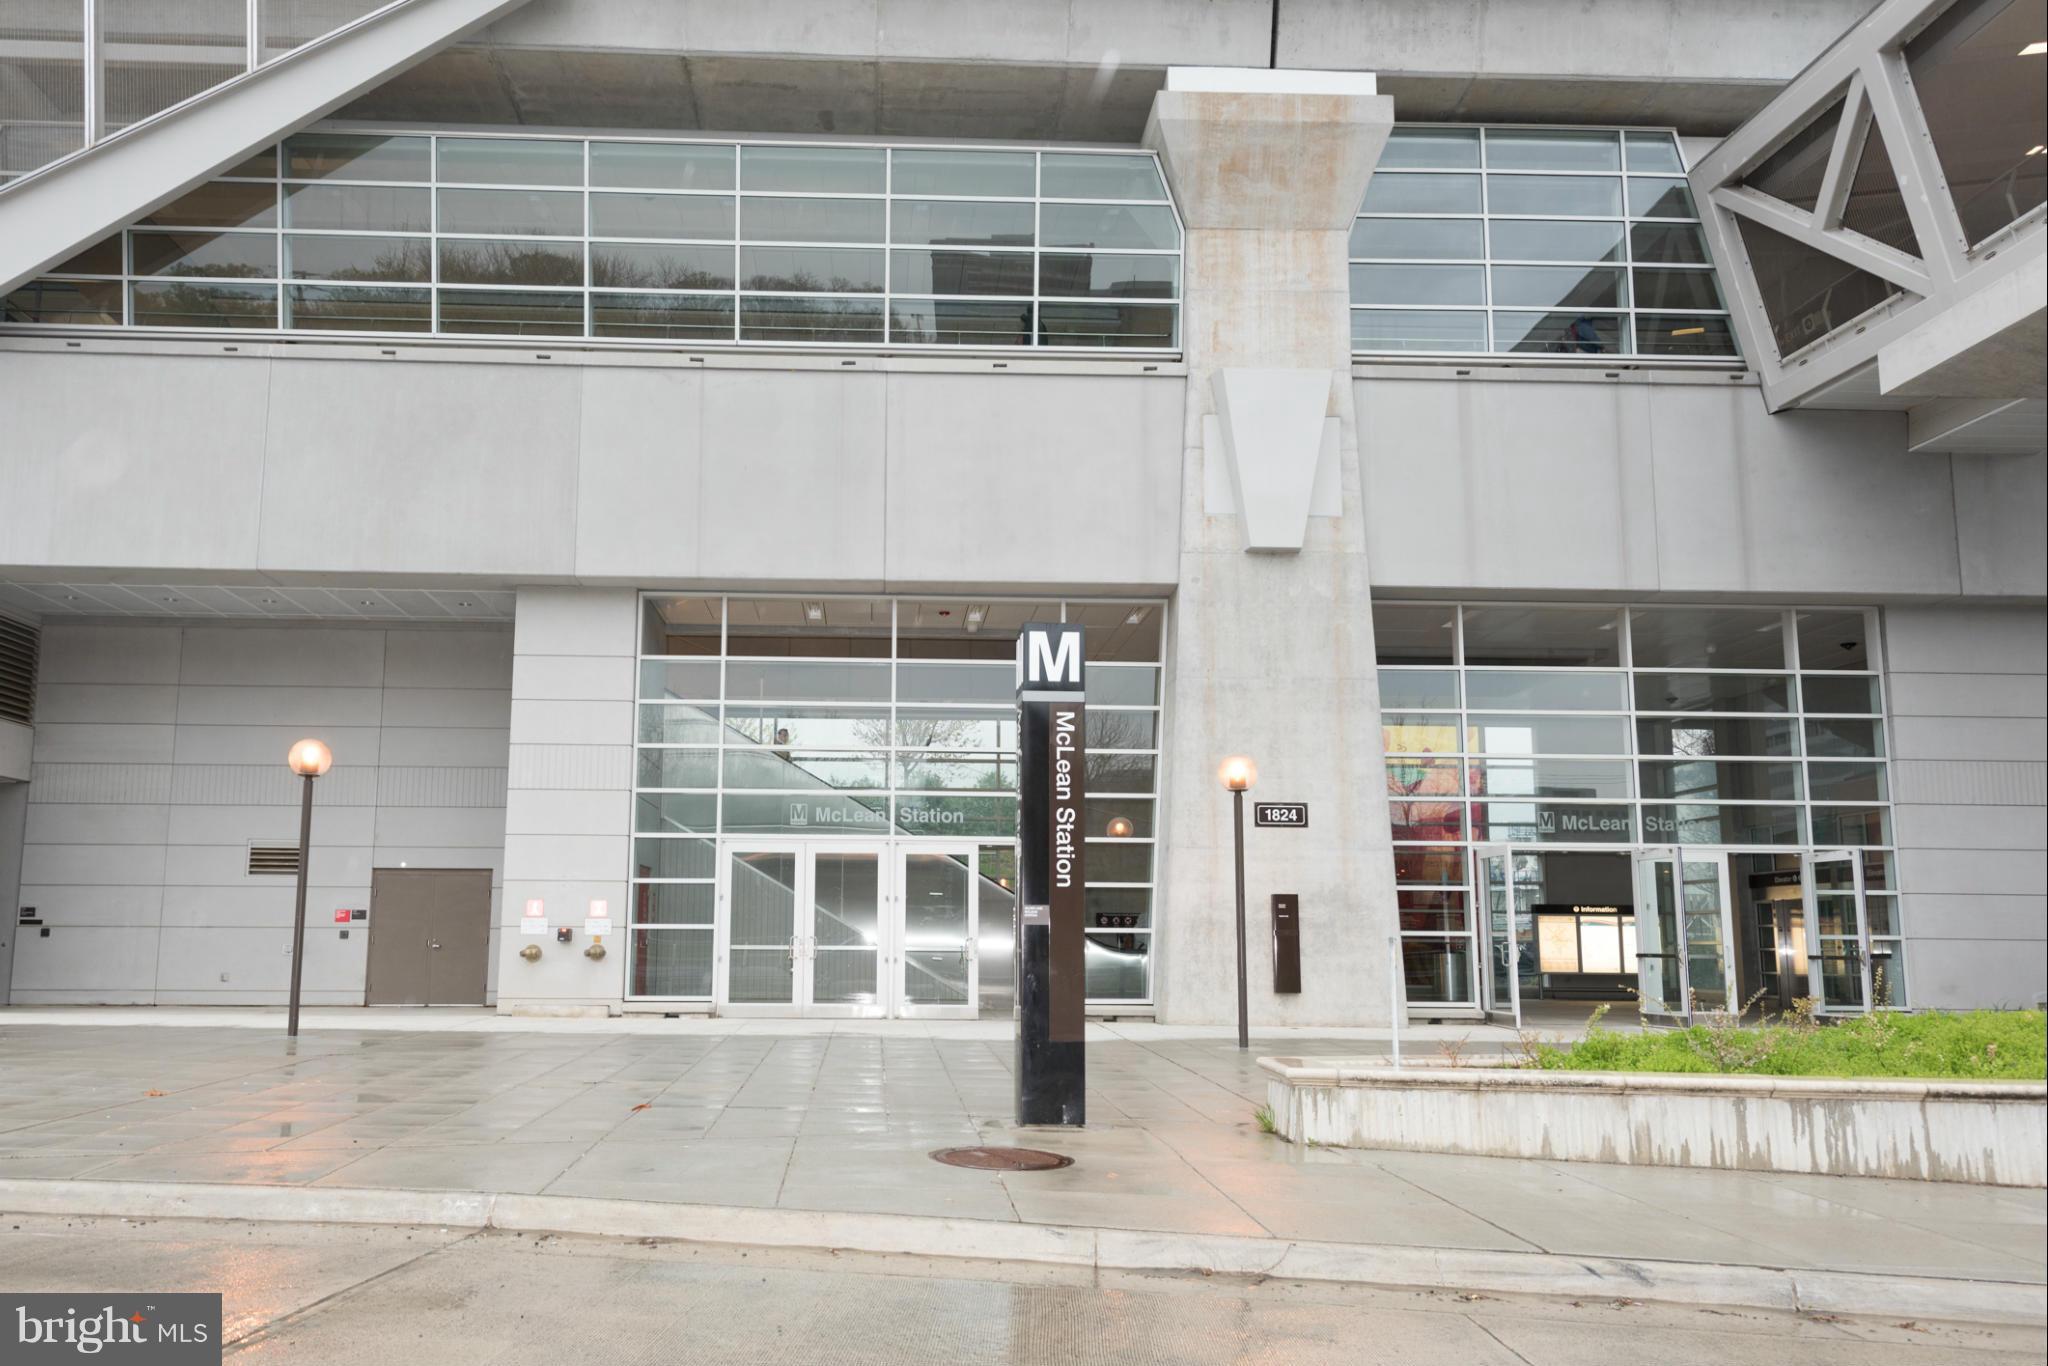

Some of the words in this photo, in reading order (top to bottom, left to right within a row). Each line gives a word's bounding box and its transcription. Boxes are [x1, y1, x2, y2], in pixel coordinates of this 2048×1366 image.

[1029, 630, 1080, 682] M
[1056, 711, 1075, 800] McLean
[816, 807, 886, 823] McLean
[900, 807, 964, 824] Station
[1265, 809, 1298, 821] 1824
[1562, 815, 1631, 831] McLean
[1056, 807, 1076, 887] Station
